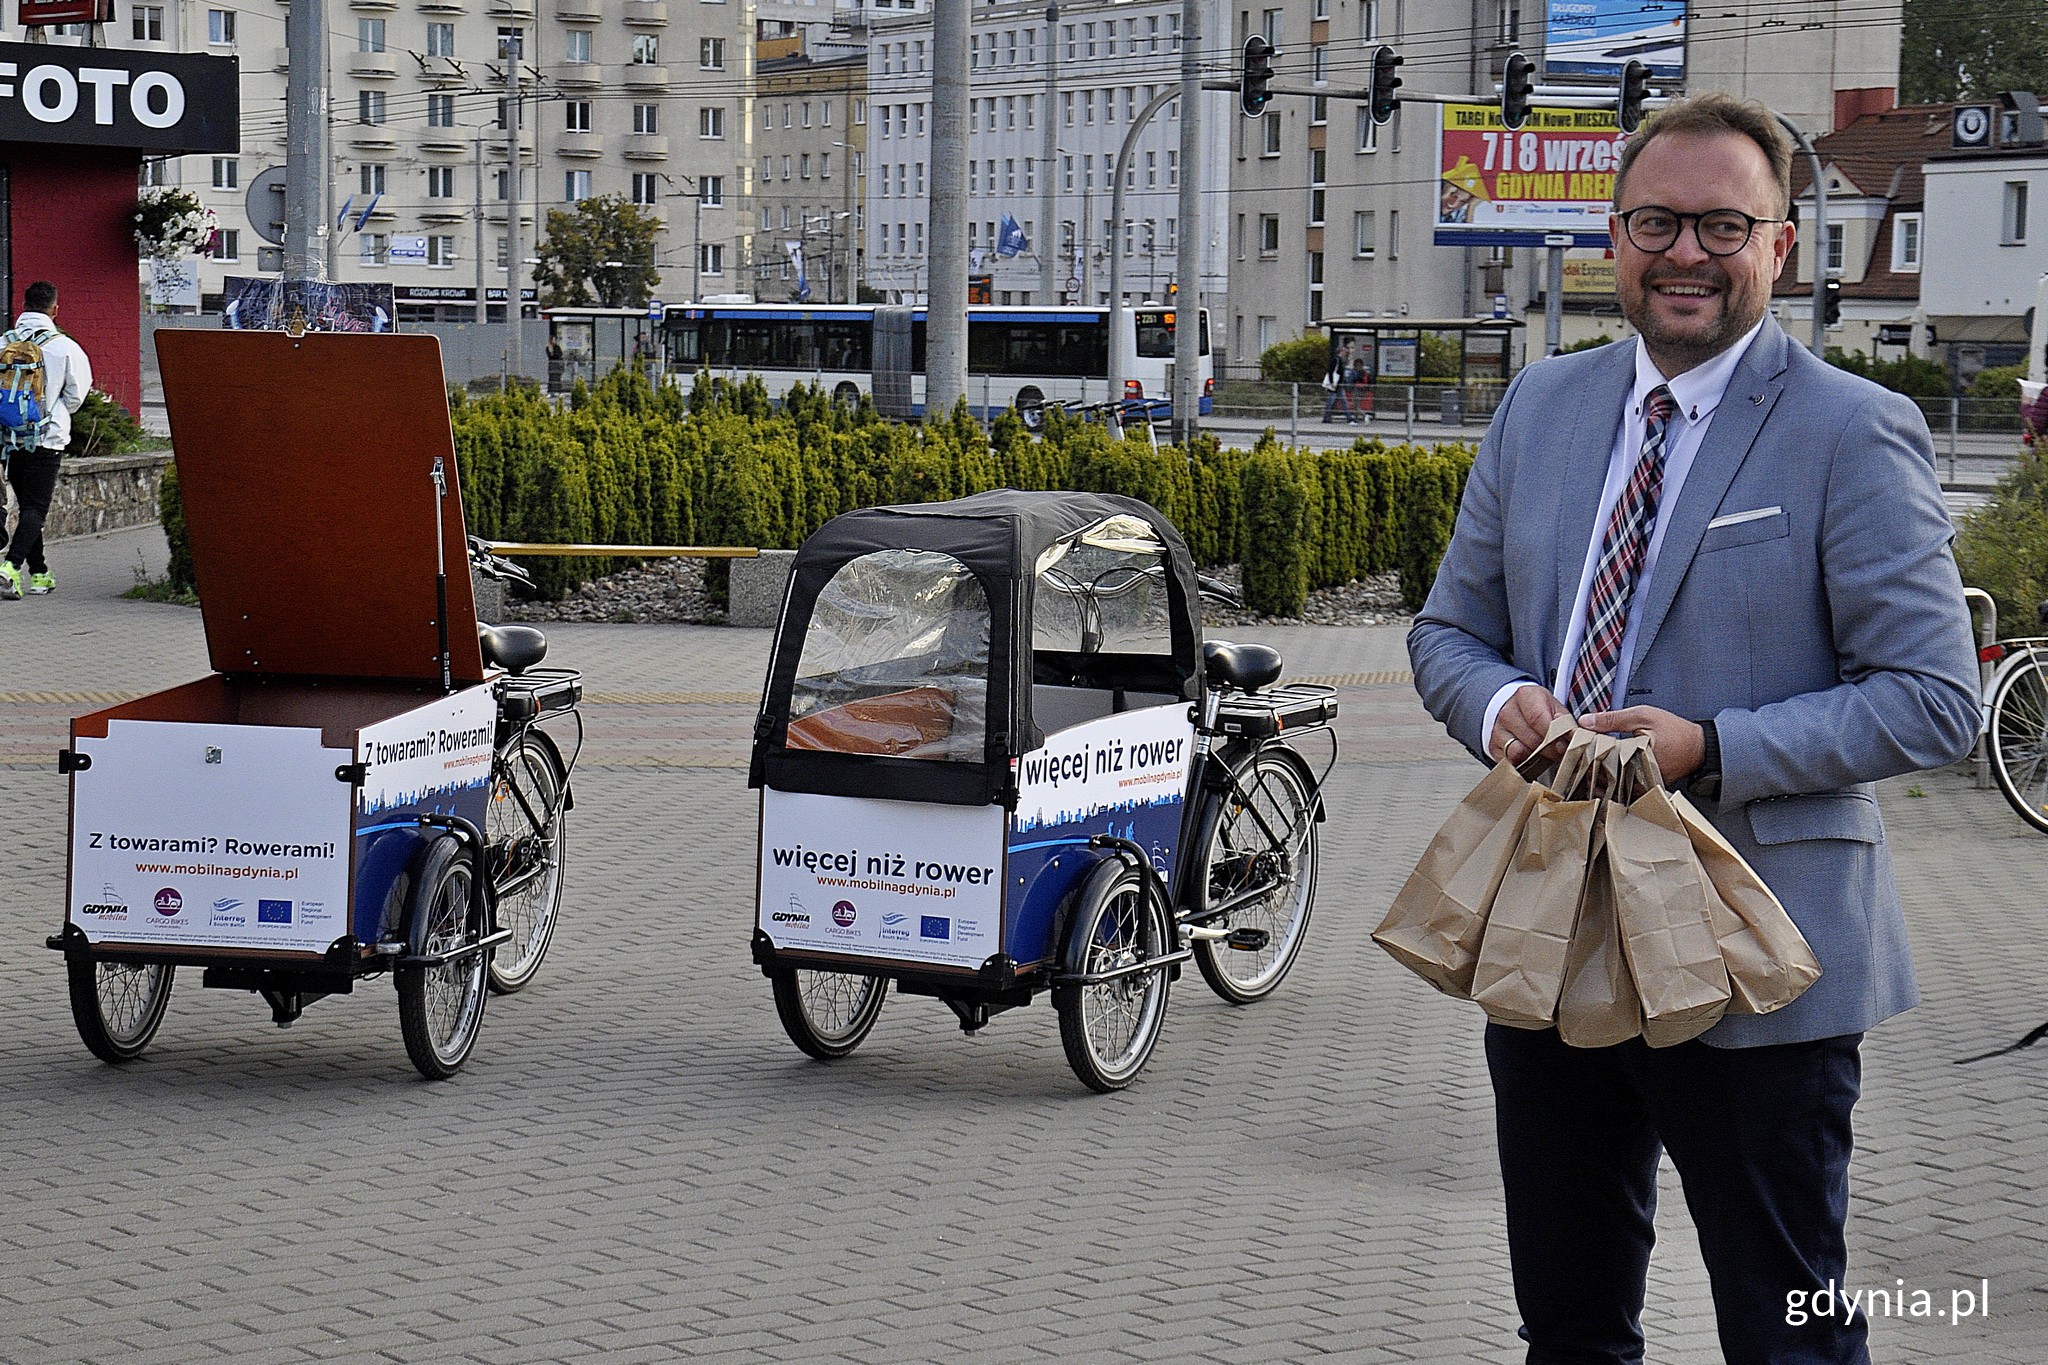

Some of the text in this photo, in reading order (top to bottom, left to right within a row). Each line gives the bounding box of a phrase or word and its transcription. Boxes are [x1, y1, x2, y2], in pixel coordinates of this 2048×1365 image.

[1456, 111, 1484, 126] TARGI
[1544, 113, 1572, 127] Nowe
[1574, 113, 1617, 128] MIESZKA
[1482, 133, 1627, 172] 7 i 8 wrześ
[1496, 173, 1616, 200] GDYNIA AREN
[365, 720, 494, 767] Z towarami? Rowerami!
[1026, 737, 1184, 789] więcej niż rower
[1118, 768, 1183, 788] www.mobilnagdynia.pl
[89, 833, 335, 859] Z towarami? Rowerami!
[135, 863, 299, 880] www.mobilnagdynia.pl
[772, 844, 994, 885] więcej niż rower
[817, 876, 956, 899] www.mobilnagdynia.pl
[82, 904, 128, 914] GDYNIA
[772, 912, 810, 922] GDYNIA
[145, 917, 190, 926] CARGO BIKES
[825, 927, 845, 935] CARGO
[846, 929, 861, 937] BIKES
